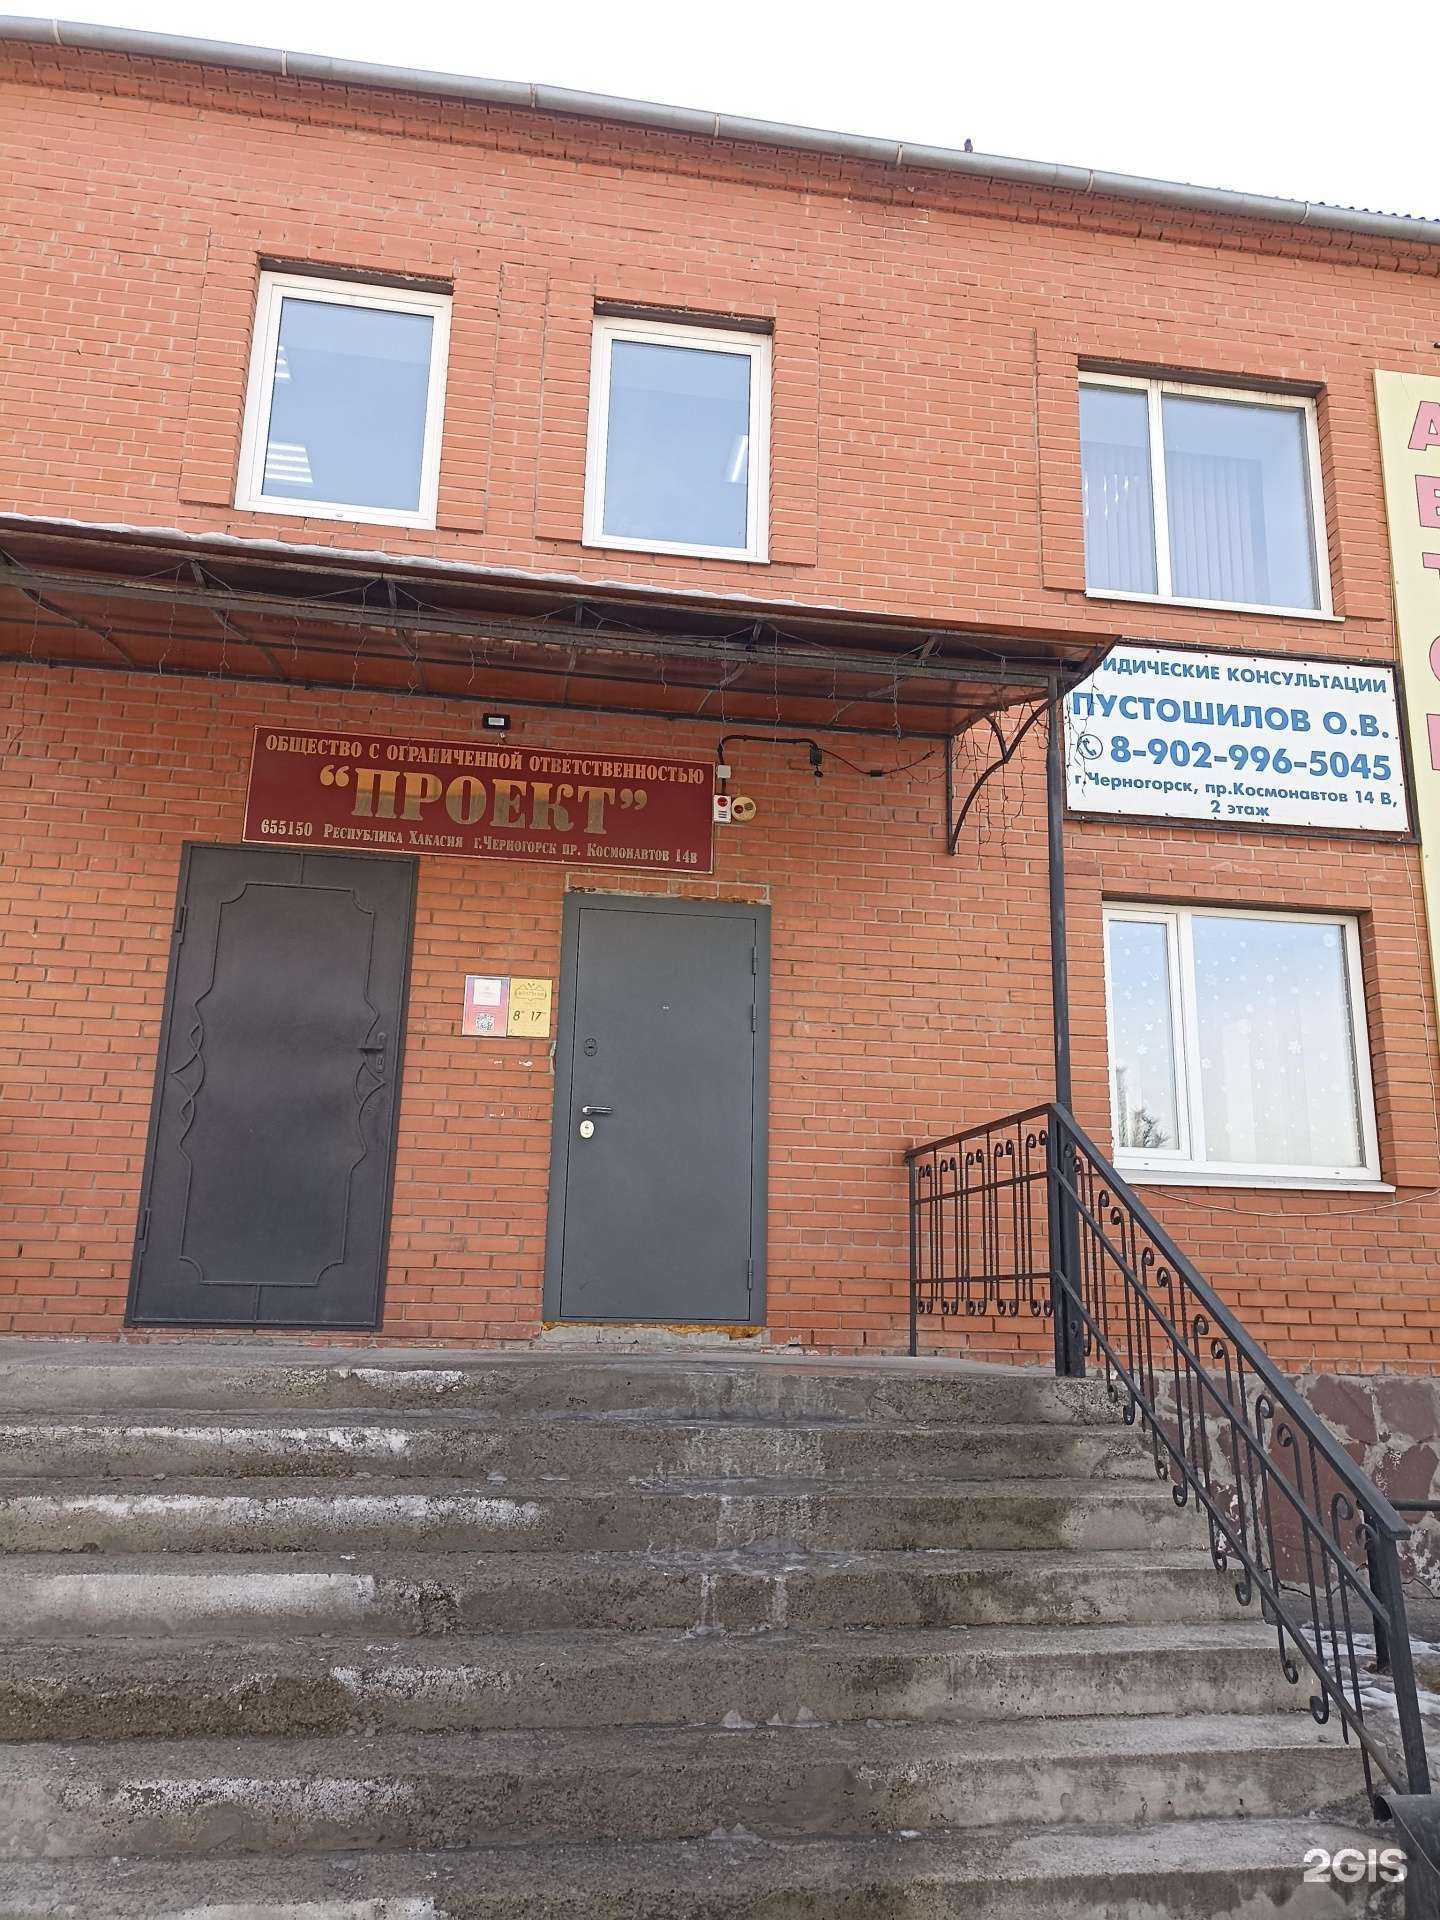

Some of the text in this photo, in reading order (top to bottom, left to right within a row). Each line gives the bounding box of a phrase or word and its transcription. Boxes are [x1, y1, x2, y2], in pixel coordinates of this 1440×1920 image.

[1102, 657, 1387, 693] ИДИЧЕСКИЕ КОНСУЛЬТАЦИИ
[1072, 692, 1389, 739] ПУСТОШИЛОВ О.В.
[265, 735, 705, 785] ОБЩЕСТВО С ОГРАНИЧЕННОЙ ОТВЕТСТВЕННОСТЬЮ
[1110, 735, 1392, 781] 8-902-996-5045
[1205, 783, 1348, 803] пр.Космонавтов
[1355, 790, 1375, 804] 14
[1210, 799, 1270, 817] 2 этаж
[260, 818, 313, 837] 655150
